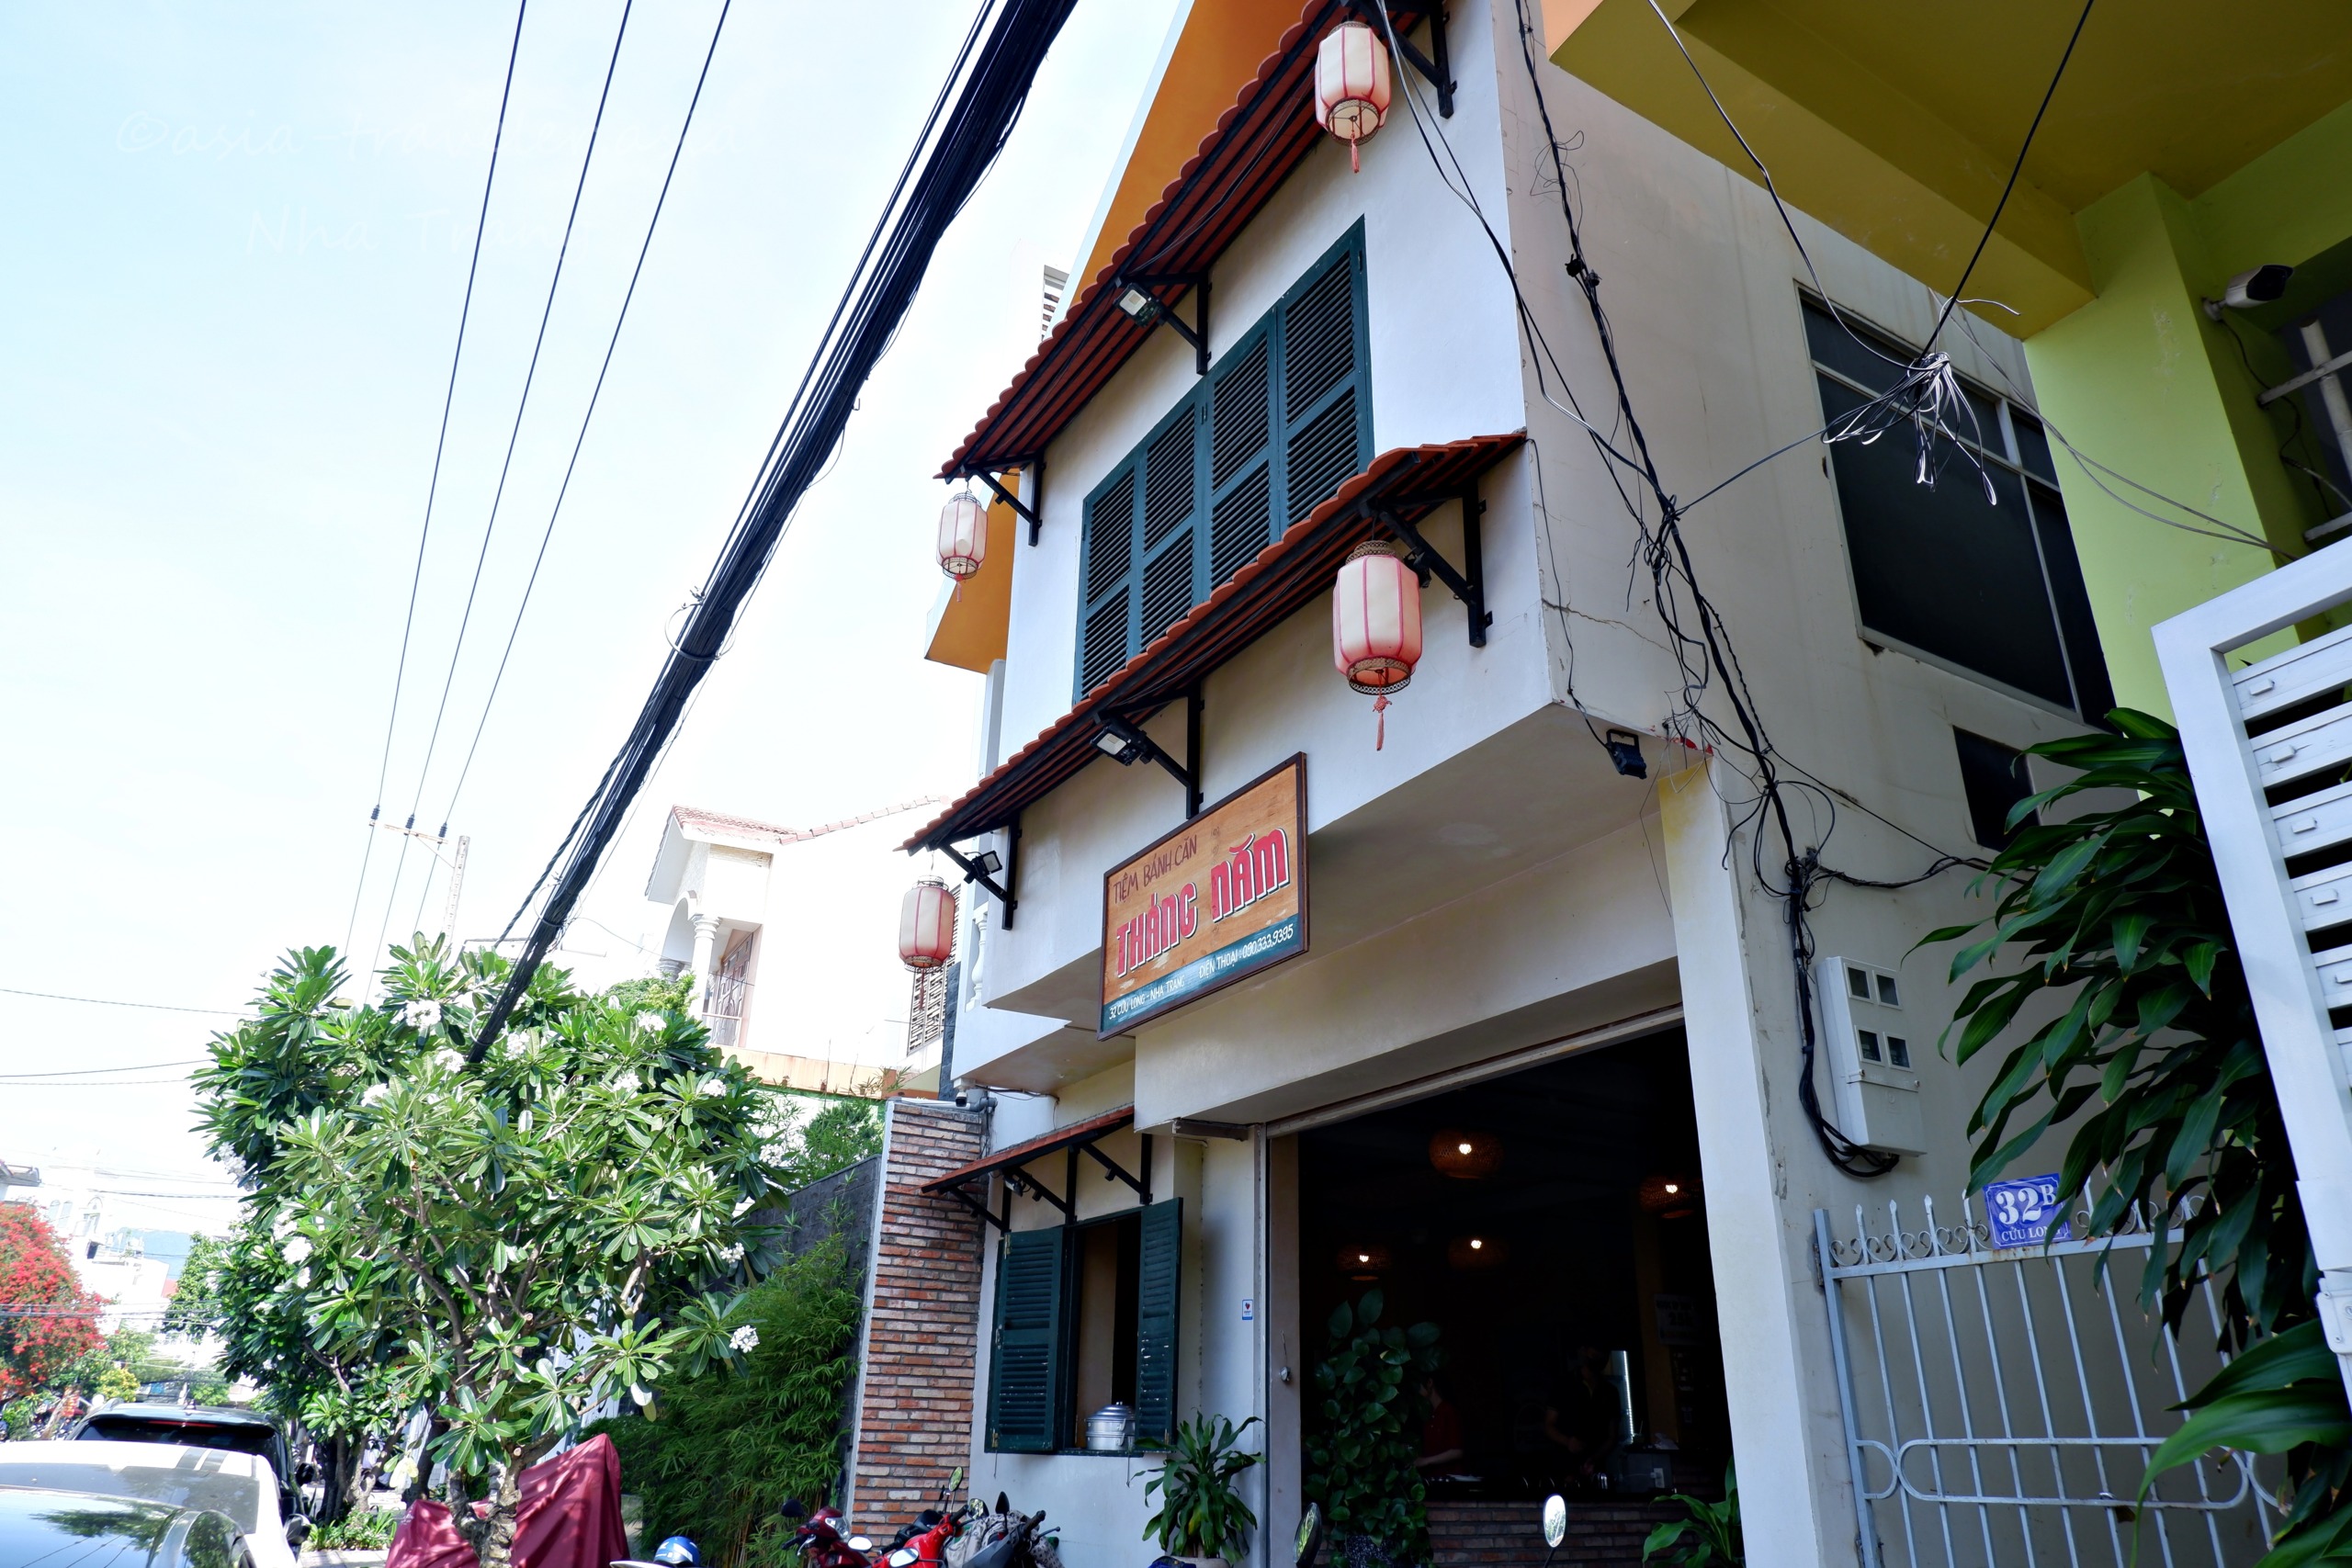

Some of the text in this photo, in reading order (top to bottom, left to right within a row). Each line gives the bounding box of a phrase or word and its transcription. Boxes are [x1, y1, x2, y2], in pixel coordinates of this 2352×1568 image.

[1114, 834, 1197, 904] TIỆM BÁNH CĂN
[1116, 828, 1291, 978] THÁNG NĂM
[1198, 959, 1216, 978] ĐIỆN
[1130, 994, 1146, 1010] LONG
[1149, 985, 1164, 1000] NHA
[1165, 976, 1185, 993] TRANG
[2001, 1226, 2026, 1242] CỬU
